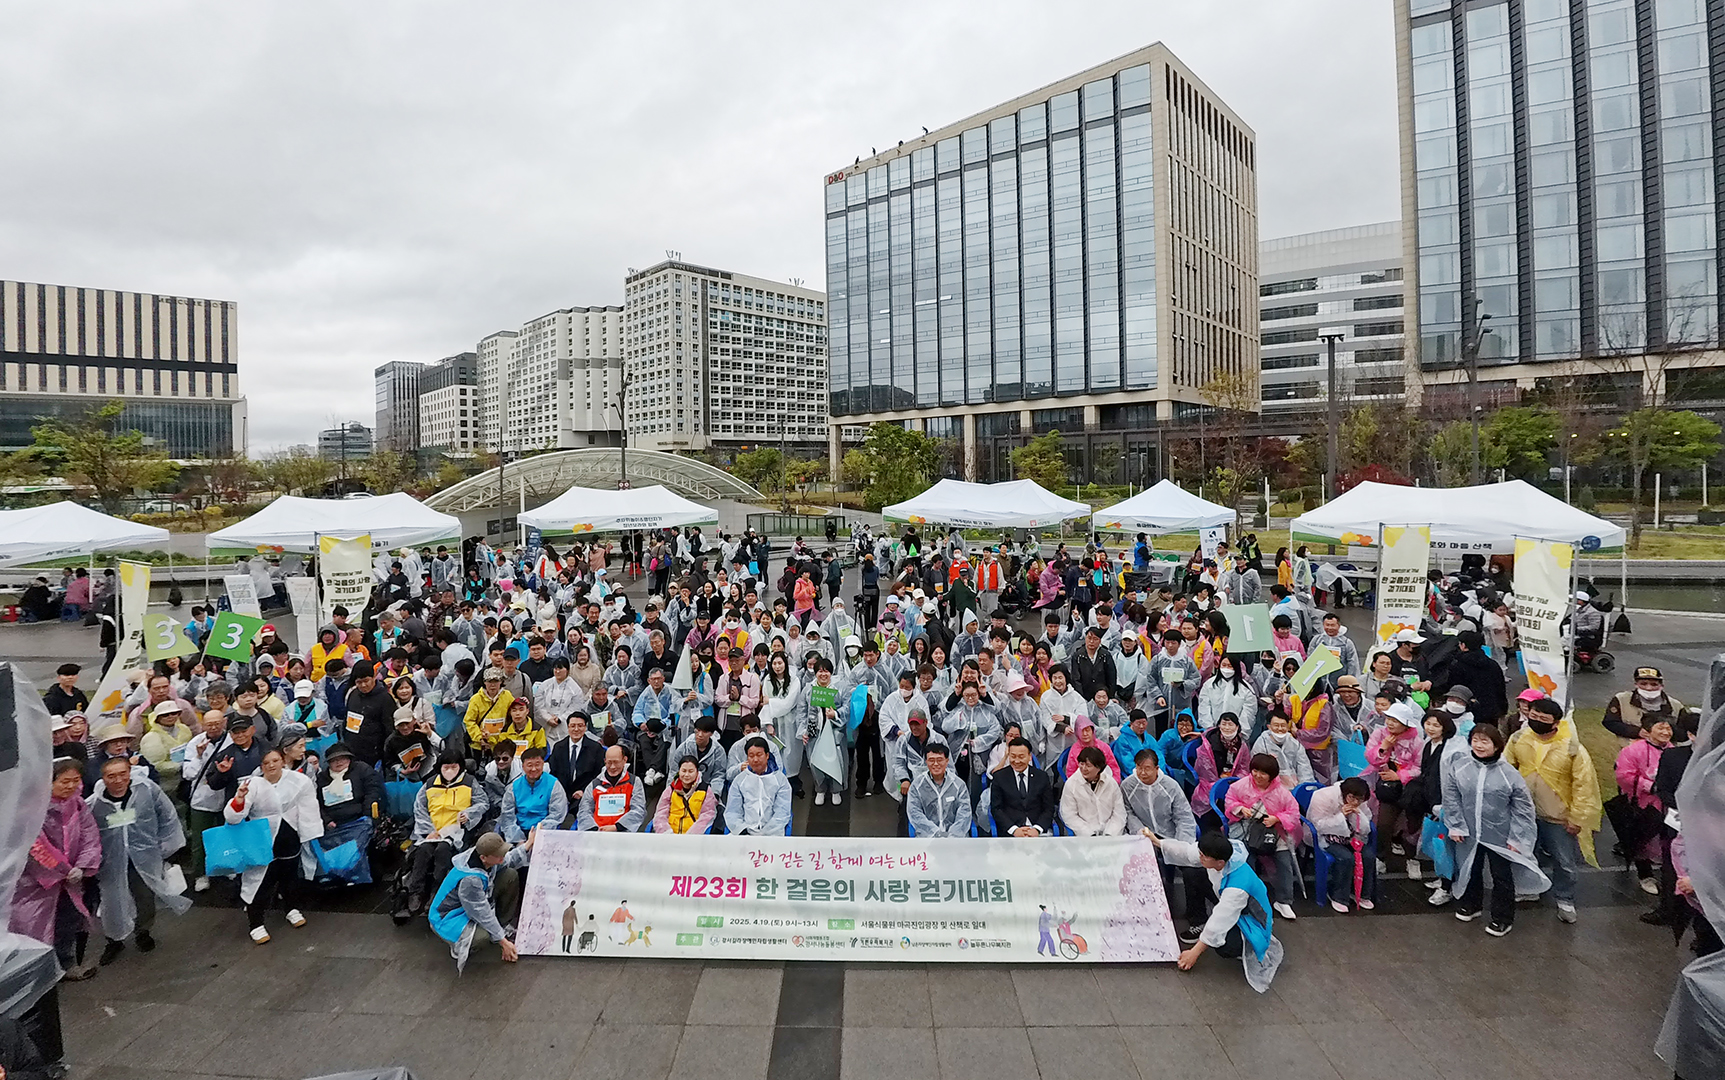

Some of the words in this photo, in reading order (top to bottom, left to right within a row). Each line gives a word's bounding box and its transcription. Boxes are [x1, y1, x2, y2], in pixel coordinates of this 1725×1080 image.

[1450, 542, 1469, 550] 마음
[1535, 608, 1559, 621] 사랑
[155, 620, 177, 651] 3
[220, 623, 244, 650] 3
[748, 849, 774, 868] 같이
[779, 850, 804, 869] 걷는
[827, 849, 863, 870] 함께
[868, 853, 895, 870] 여는
[899, 851, 929, 871] 내일
[669, 875, 747, 899] 제23회
[755, 877, 779, 900] 한
[786, 878, 855, 902] 걸음의
[864, 879, 911, 903] 사랑
[918, 879, 1013, 903] 걷기대회
[860, 920, 896, 930] 서울식물원
[896, 920, 939, 930] 마곡진입광장
[940, 921, 948, 930] 및
[949, 921, 970, 930] 산책로
[971, 921, 987, 930] 일대
